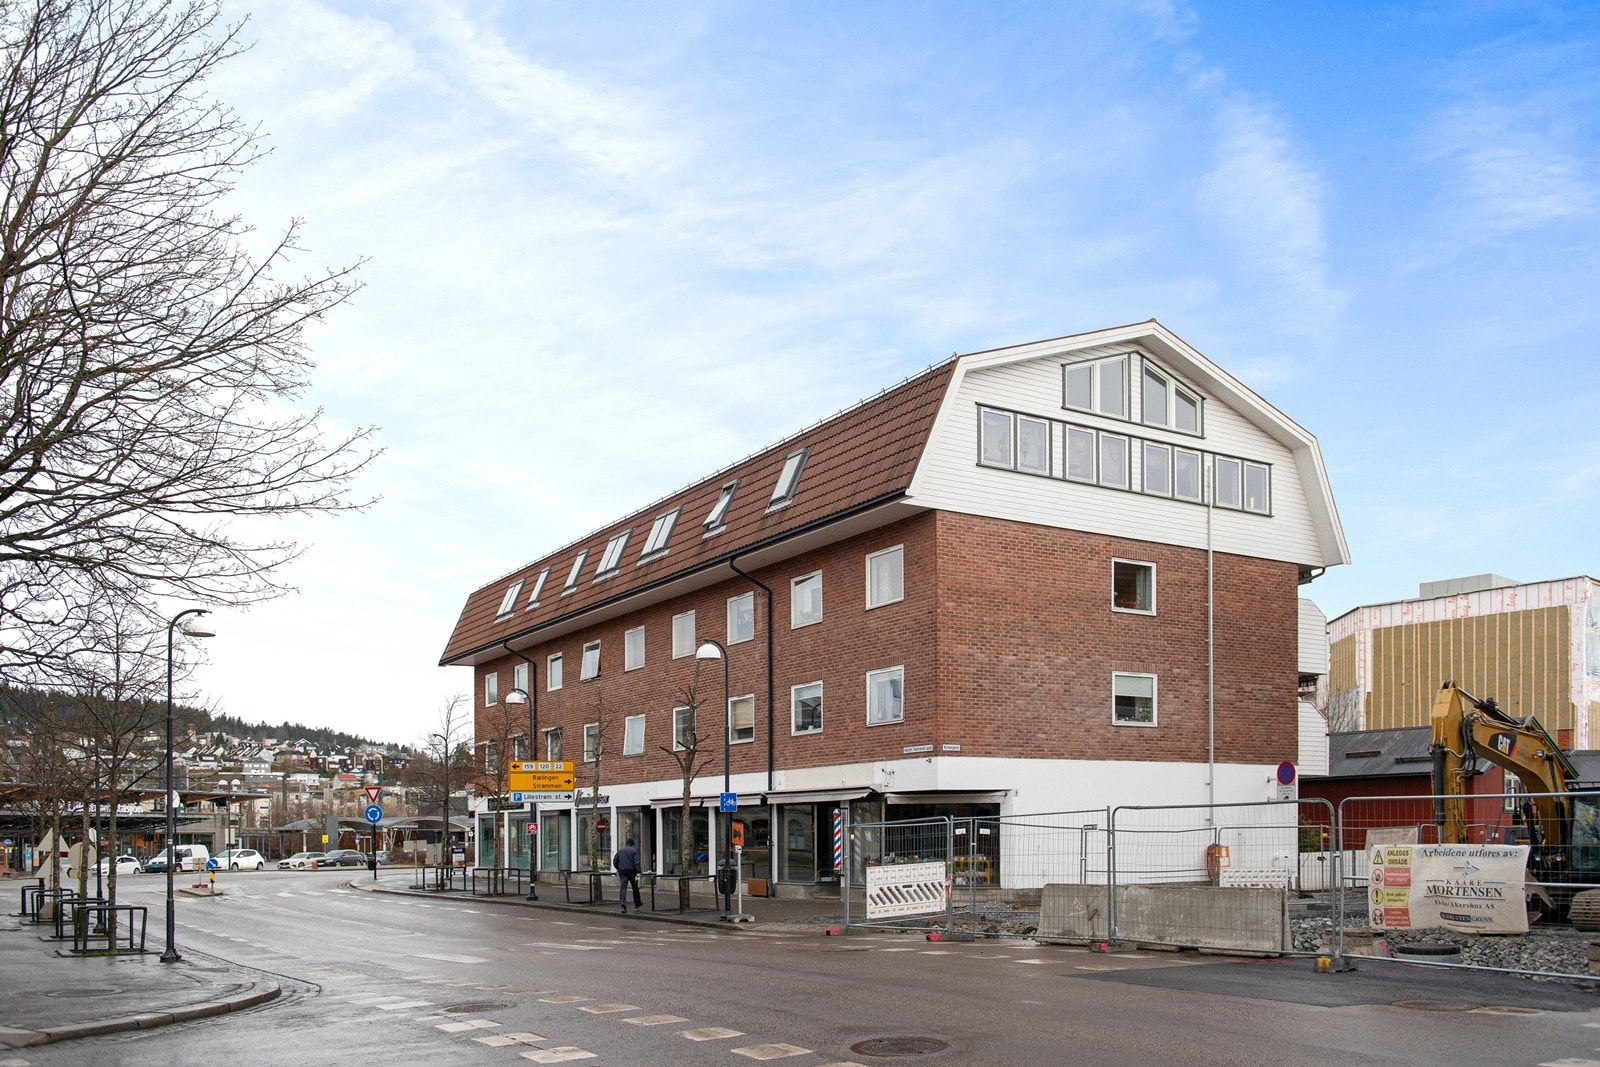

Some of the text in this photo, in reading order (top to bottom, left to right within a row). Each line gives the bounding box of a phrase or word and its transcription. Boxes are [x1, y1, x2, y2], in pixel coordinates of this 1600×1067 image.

[1498, 734, 1510, 755] CAT
[1421, 848, 1467, 858] Arbeidene
[1502, 850, 1518, 858] av:
[1426, 885, 1502, 898] MORTENSEN
